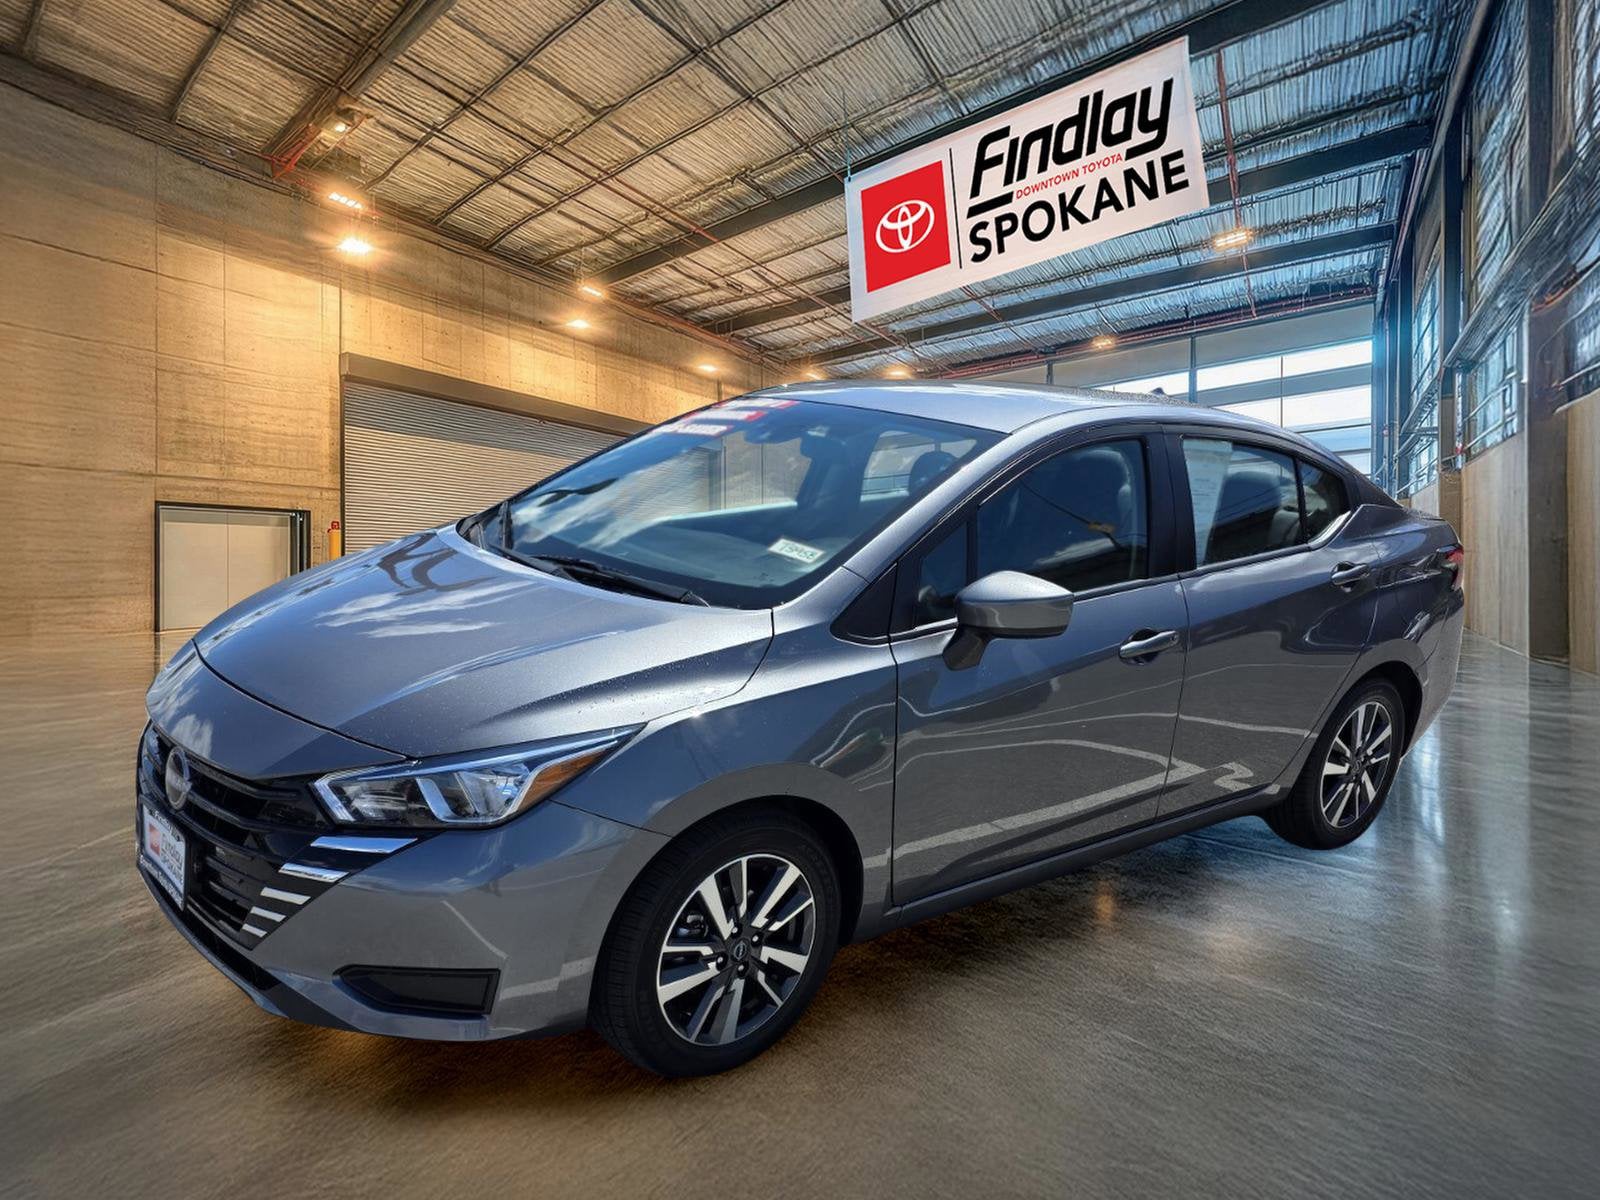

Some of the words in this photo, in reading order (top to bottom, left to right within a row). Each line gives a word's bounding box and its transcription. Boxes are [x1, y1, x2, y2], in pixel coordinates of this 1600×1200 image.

[969, 78, 1174, 200] Findlay
[1015, 168, 1080, 200] DOWNTOWN
[1082, 152, 1123, 175] TOYOTA
[968, 149, 1190, 263] SPOKANE
